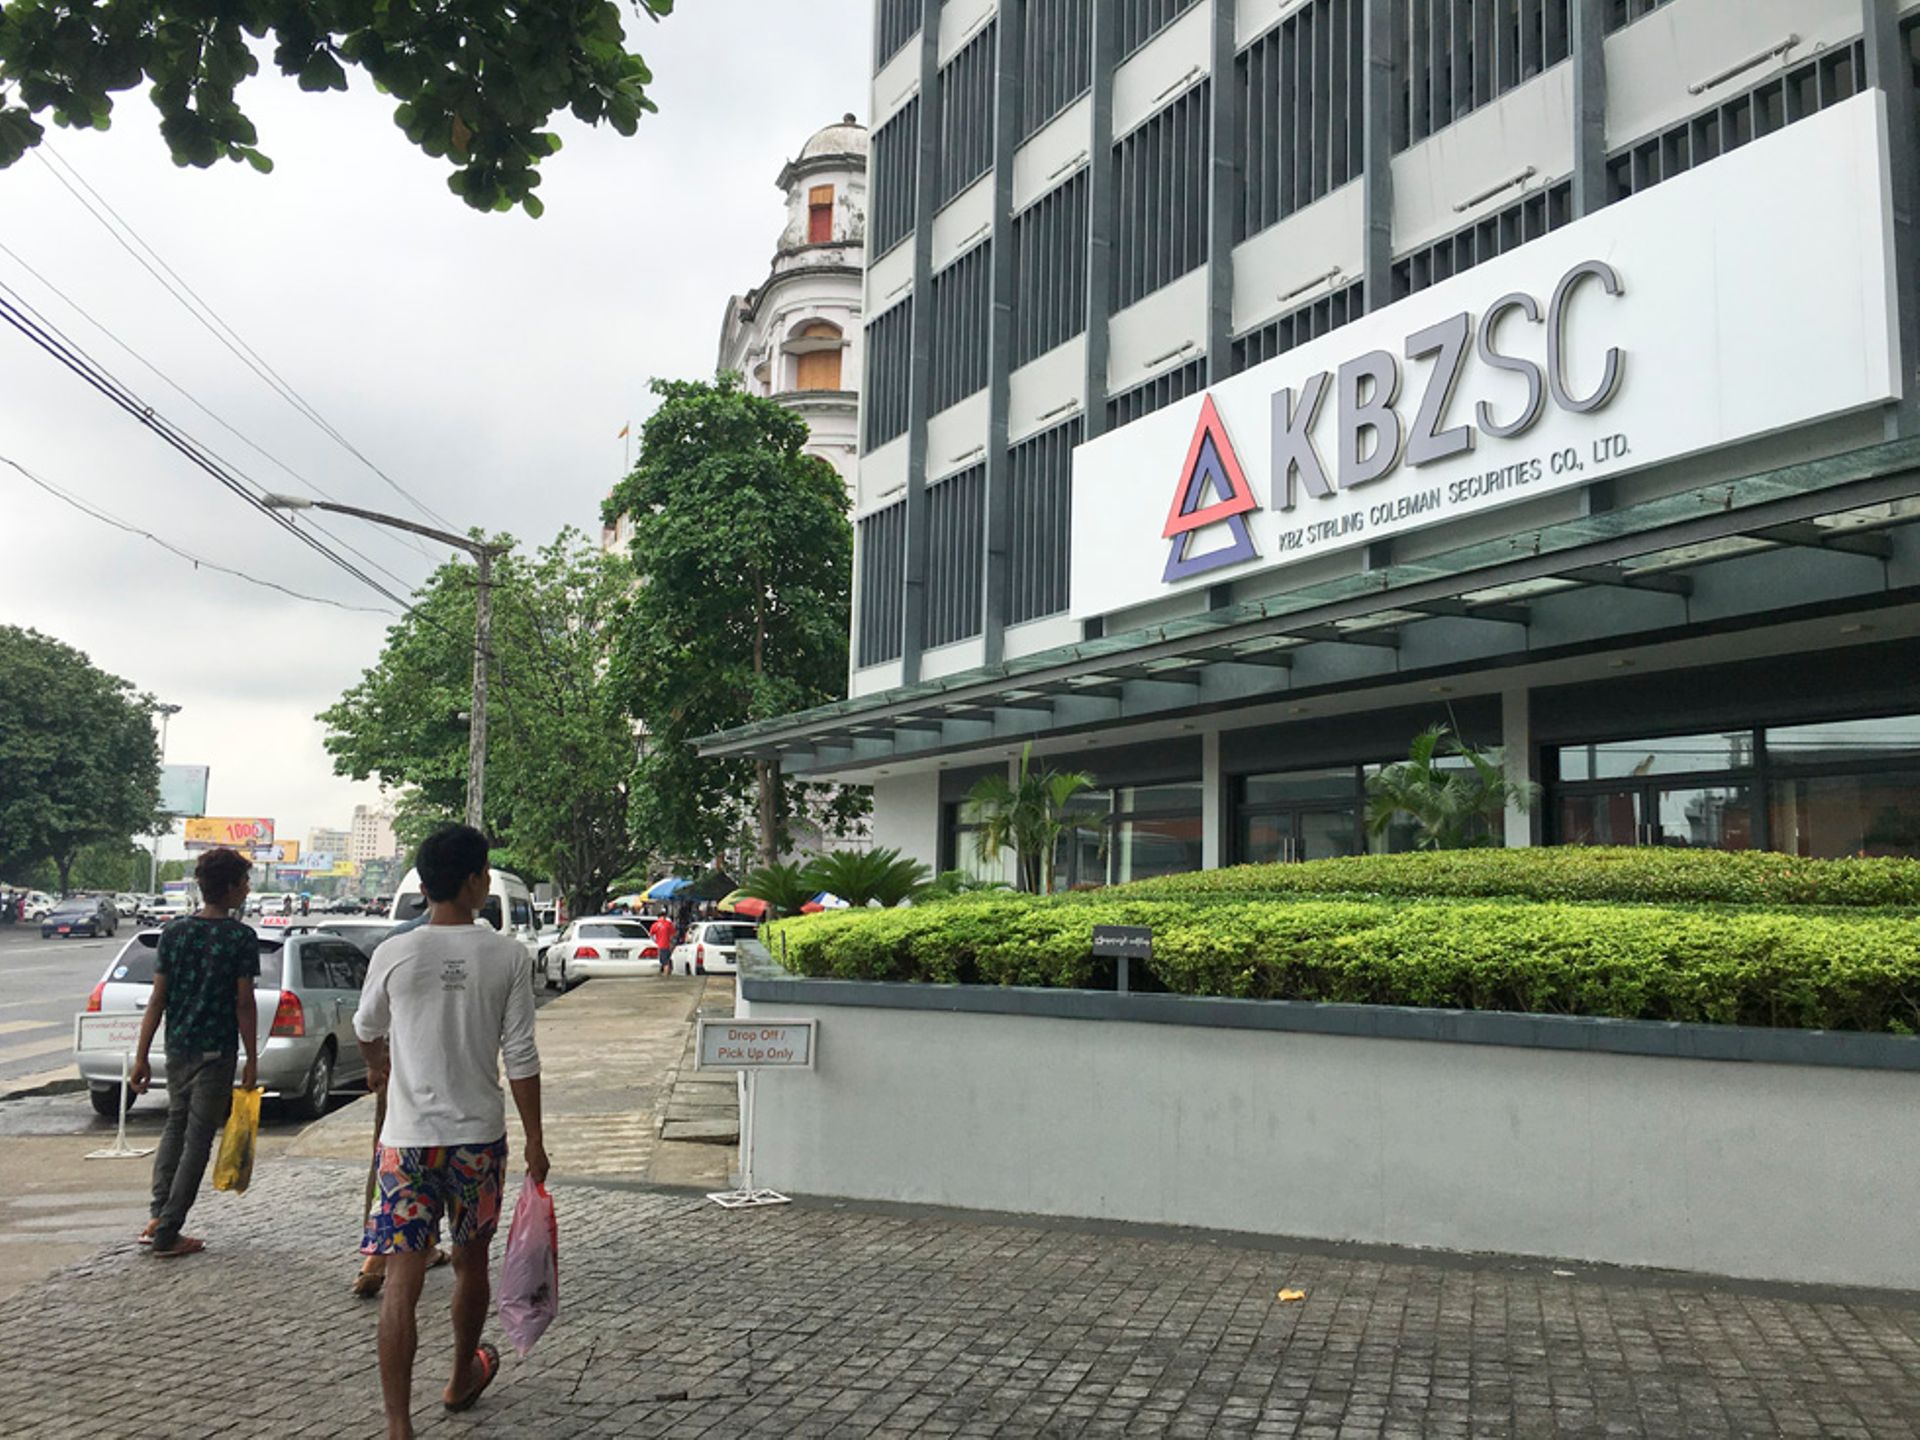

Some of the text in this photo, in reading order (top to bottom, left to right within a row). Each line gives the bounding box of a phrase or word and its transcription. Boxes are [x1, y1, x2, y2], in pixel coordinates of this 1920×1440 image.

[1271, 260, 1625, 511] KBZSC
[1279, 529, 1303, 552] KBZ
[1307, 512, 1363, 544] STIRLING
[1370, 487, 1441, 526] COLEMAN
[1449, 459, 1542, 505] SECURITIES
[1593, 433, 1632, 463] LTD.
[718, 1047, 794, 1060] Pick Up Only
[728, 1029, 756, 1042] Drop
[761, 1029, 778, 1041] Off
